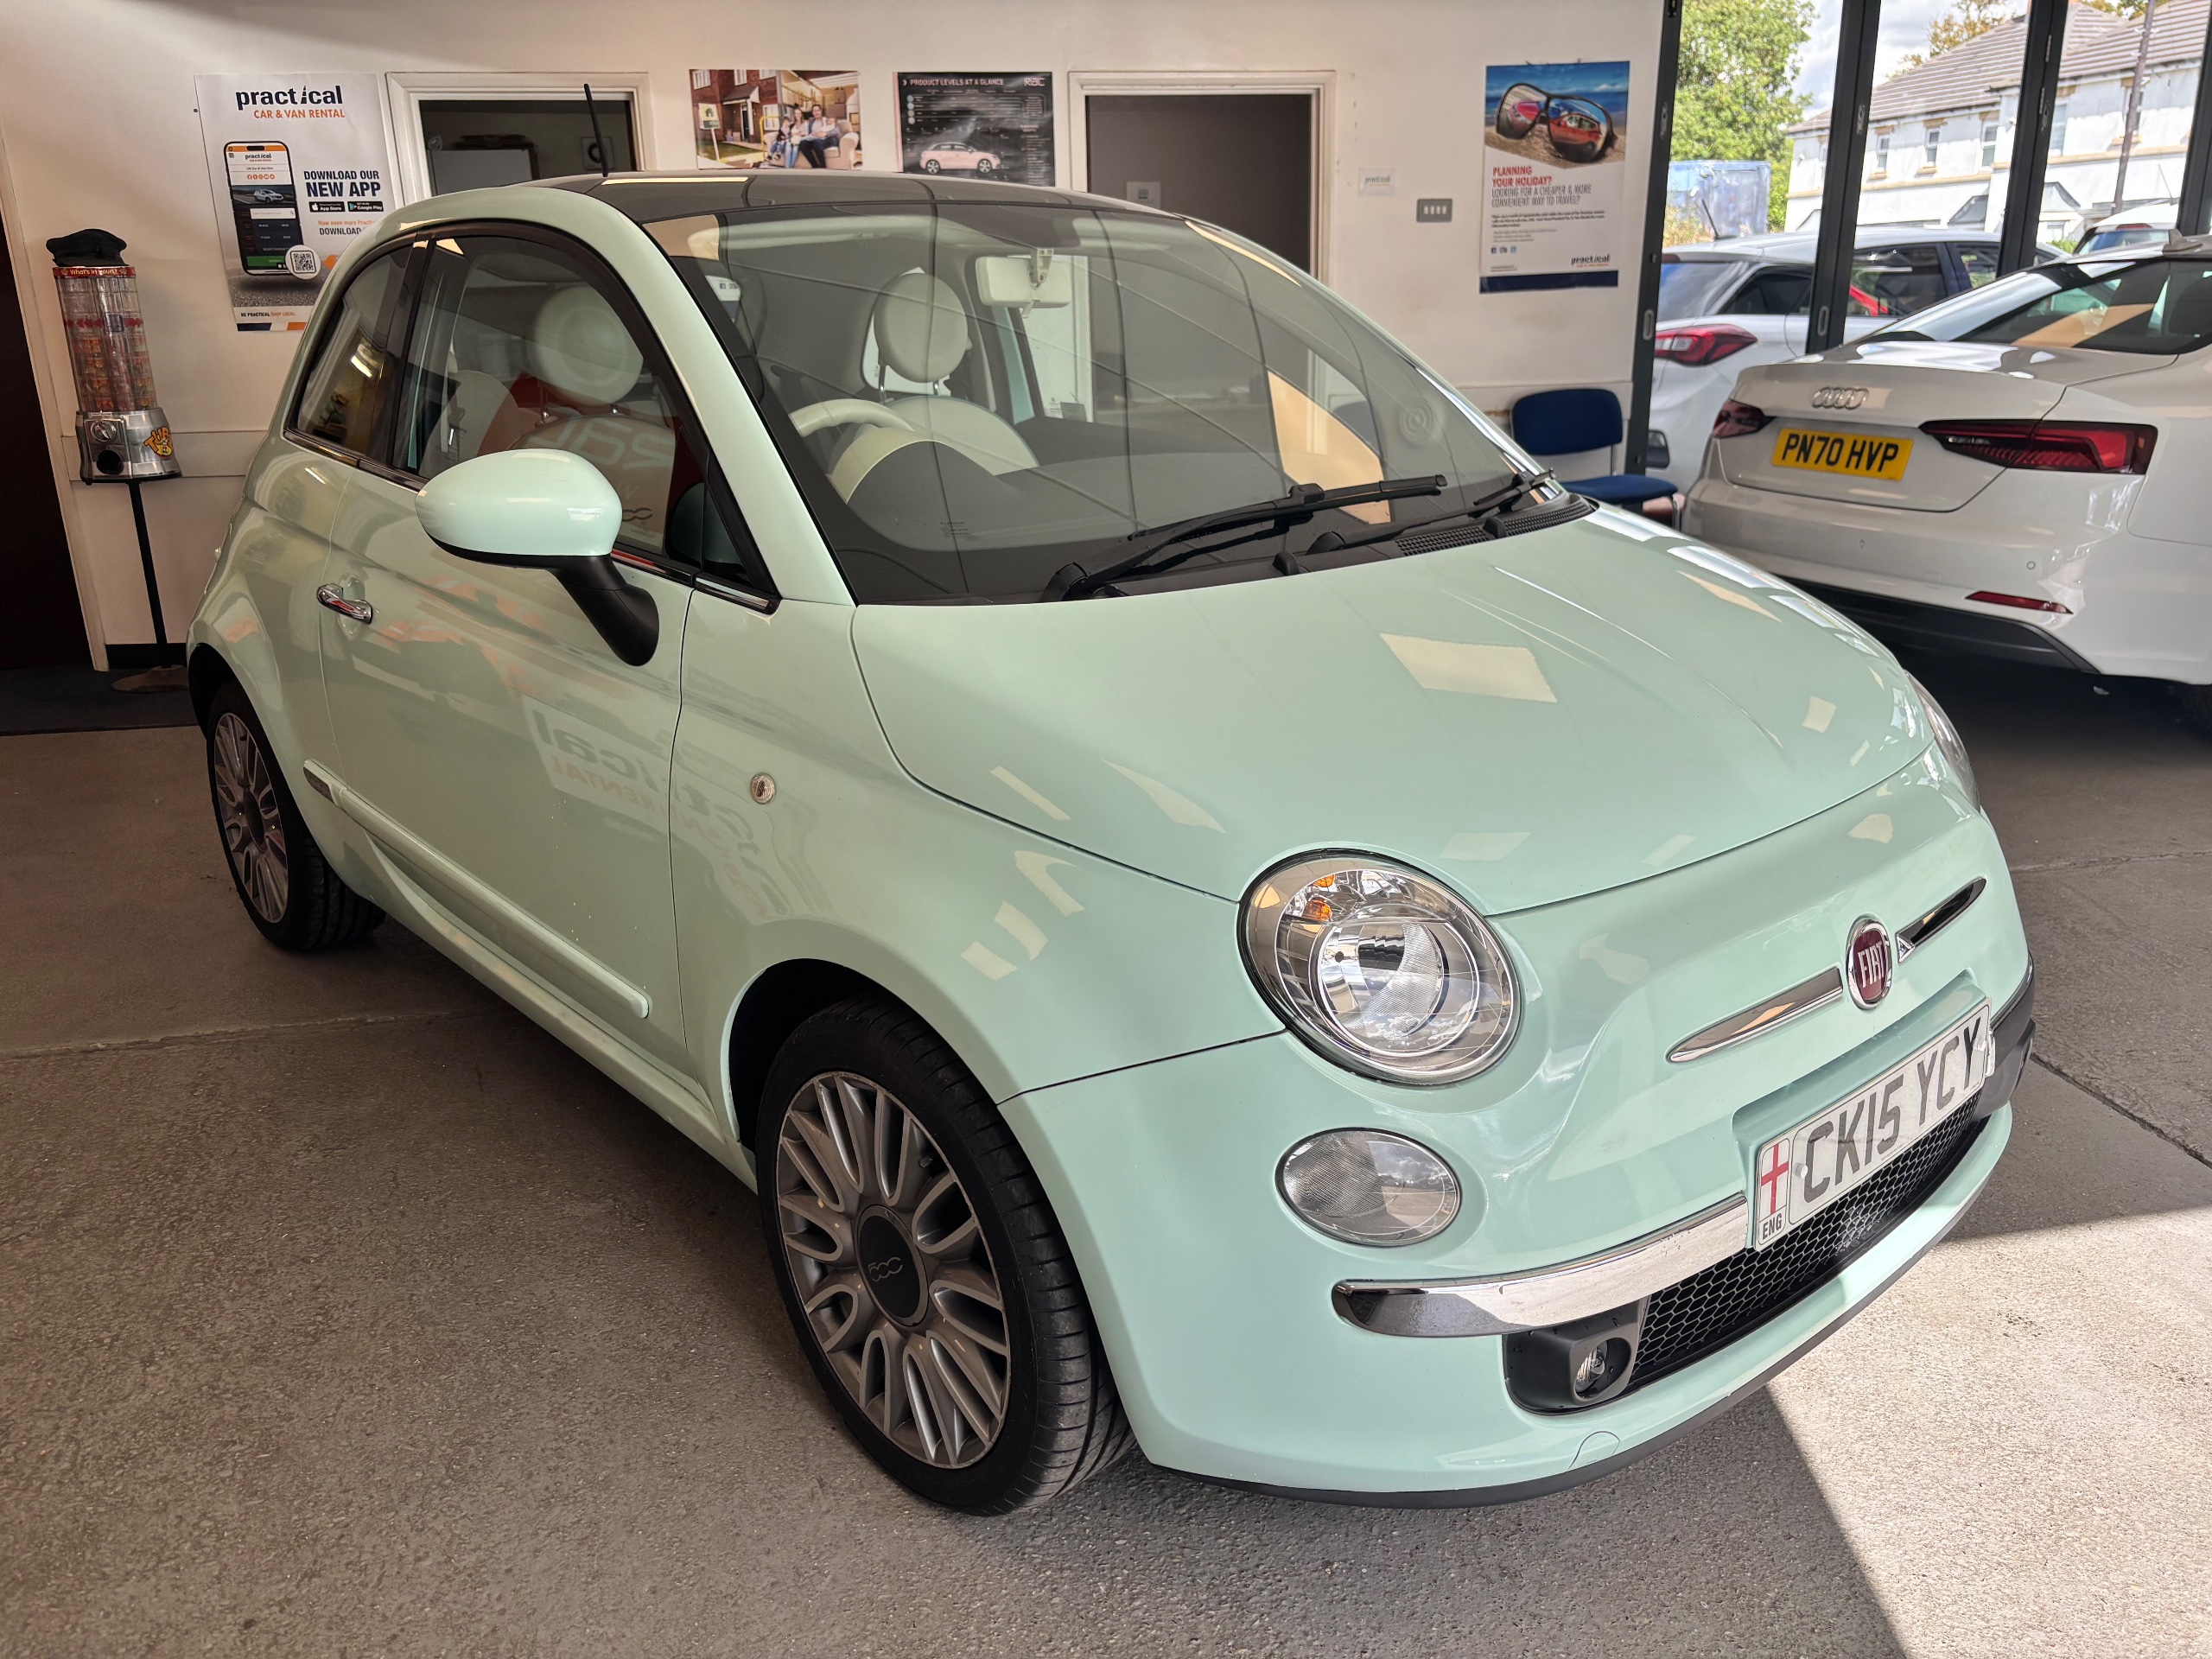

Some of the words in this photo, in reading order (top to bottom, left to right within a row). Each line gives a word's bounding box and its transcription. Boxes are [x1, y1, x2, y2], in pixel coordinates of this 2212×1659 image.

[236, 86, 343, 111] practical
[253, 110, 273, 118] CAR
[276, 110, 283, 118] &
[284, 110, 306, 118] VAN
[308, 109, 345, 118] RENTAL
[304, 170, 357, 180] DOWNLOAD
[359, 170, 379, 180] OUR
[1493, 166, 1532, 176] PLANNING
[306, 181, 343, 198] NEW
[349, 181, 381, 197] APP
[1492, 178, 1513, 188] YOUR
[1515, 175, 1552, 187] HOLIDAY?
[1491, 187, 1519, 198] LOOKING
[1520, 187, 1532, 196] FOR
[1539, 185, 1566, 195] CHEAPER
[1573, 183, 1592, 194] MORE
[1491, 197, 1530, 208] CONVENIENT
[1531, 196, 1545, 207] WAY
[1547, 196, 1555, 206] TO
[1556, 194, 1580, 206] TRAVEL?
[1571, 253, 1611, 266] practical
[1782, 433, 1844, 467] PN70
[1846, 439, 1899, 473] HVP
[1857, 940, 1885, 988] FIAT
[1804, 1073, 1904, 1203] CK15
[1916, 1016, 1981, 1127] YCY
[1763, 1212, 1783, 1241] ENG
[868, 1257, 904, 1282] 500
